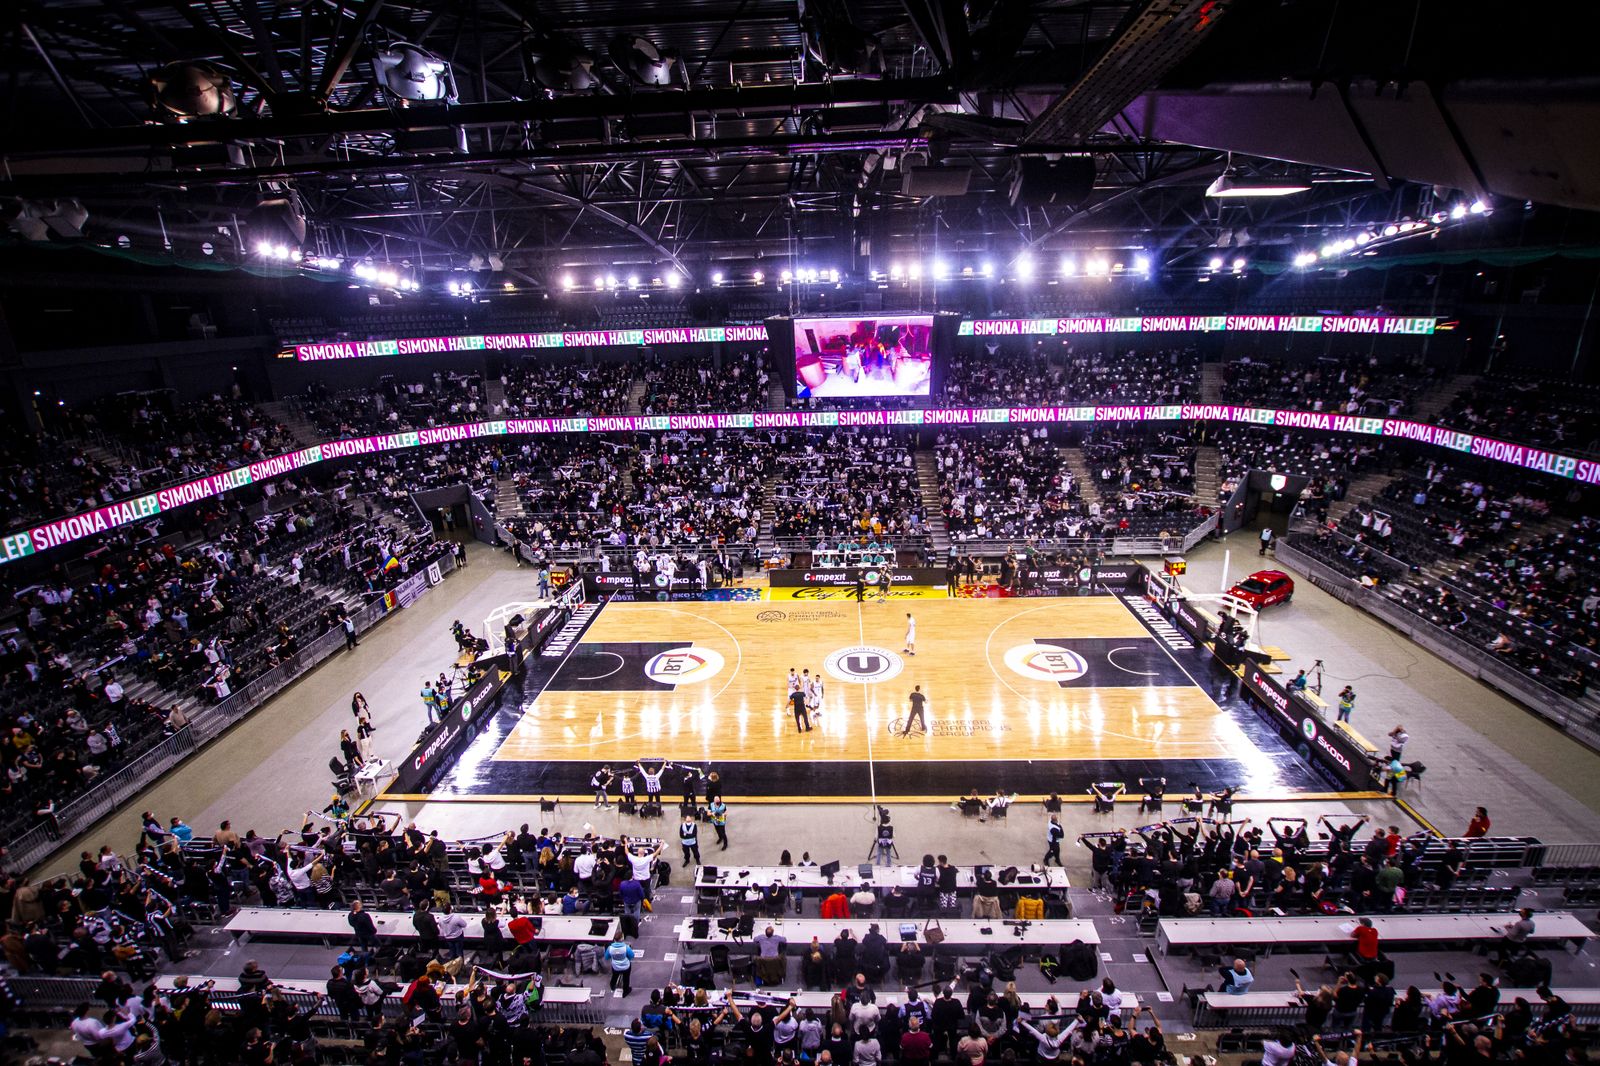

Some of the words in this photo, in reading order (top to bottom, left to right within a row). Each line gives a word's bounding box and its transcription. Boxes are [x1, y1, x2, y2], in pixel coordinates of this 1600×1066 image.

[974, 320, 1018, 335] SIMONA
[1021, 320, 1057, 334] HALEP
[1058, 319, 1103, 334] SIMONA
[1105, 318, 1141, 333] HALEP
[1143, 317, 1186, 332] SIMONA
[1189, 317, 1225, 331] HALEP
[1227, 315, 1276, 330] SIMONA
[1279, 316, 1321, 332] HALEP
[1323, 317, 1380, 333] SIMONA
[1383, 318, 1434, 334] HALEP
[486, 335, 528, 350] SIMONA
[529, 333, 563, 349] HALEP
[565, 332, 607, 347] SIMONA
[609, 330, 643, 345] HALEP
[645, 329, 688, 344] SIMONA
[690, 328, 724, 342] HALEP
[726, 326, 768, 341] SIMONA
[301, 343, 352, 361] SIMONA
[356, 341, 397, 357] HALEP
[399, 337, 446, 354] SIMONA
[448, 336, 484, 351] HALEP
[671, 415, 715, 429] SIMONA
[718, 414, 753, 428] HALEP
[755, 413, 799, 427] SIMONA
[802, 412, 837, 426] HALEP
[839, 412, 883, 425] SIMONA
[886, 410, 923, 424] HALEP
[924, 410, 969, 424] SIMONA
[972, 409, 1008, 423] HALEP
[1010, 408, 1055, 422] SIMONA
[1057, 407, 1094, 421] HALEP
[1096, 407, 1141, 421] SIMONA
[1143, 406, 1181, 420] HALEP
[1182, 405, 1230, 420] SIMONA
[1233, 407, 1274, 425] HALEP
[508, 419, 550, 433] SIMONA
[552, 418, 587, 432] HALEP
[589, 417, 632, 431] SIMONA
[635, 416, 669, 430] HALEP
[1276, 411, 1331, 429] SIMONA
[1334, 415, 1382, 434] HALEP
[420, 425, 467, 444] SIMONA
[470, 421, 506, 438] HALEP
[1384, 420, 1432, 441] SIMONA
[1434, 431, 1471, 451] HALEP
[322, 437, 374, 458] SIMONA
[377, 432, 418, 450] HALEP
[251, 456, 292, 481] SIMONA
[293, 446, 321, 468] HALEP
[1471, 439, 1522, 464] SIMONA
[1525, 450, 1575, 476] HALEP
[159, 481, 212, 510] SIMONA
[214, 466, 251, 494] HALEP
[34, 513, 108, 550] SIMONA
[108, 494, 158, 530] HALEP
[595, 575, 633, 584] Compexi
[804, 573, 846, 582] Compexit
[663, 658, 684, 672] BT
[847, 657, 881, 674] U
[1045, 654, 1069, 669] BT
[1253, 671, 1287, 710] Compexit
[415, 726, 450, 770] Compexit
[923, 877, 932, 885] 13
